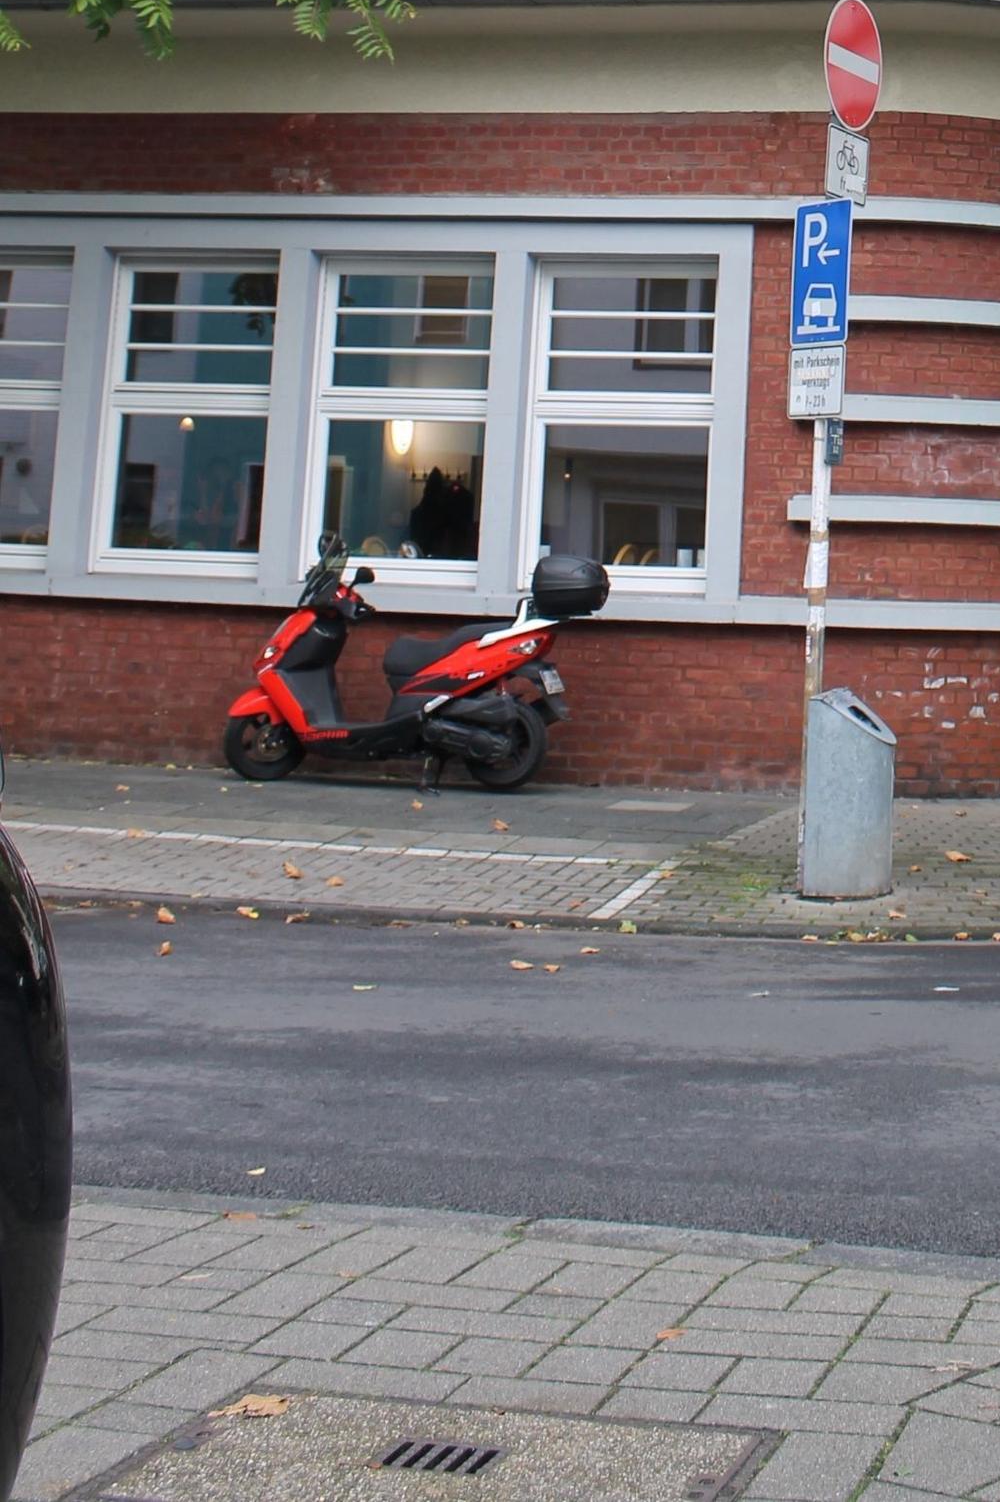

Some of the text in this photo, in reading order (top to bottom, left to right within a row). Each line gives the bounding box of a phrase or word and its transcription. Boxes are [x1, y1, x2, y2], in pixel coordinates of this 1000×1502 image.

[802, 213, 828, 267] P
[793, 354, 840, 369] mit Parkschein
[801, 378, 830, 390] werktags
